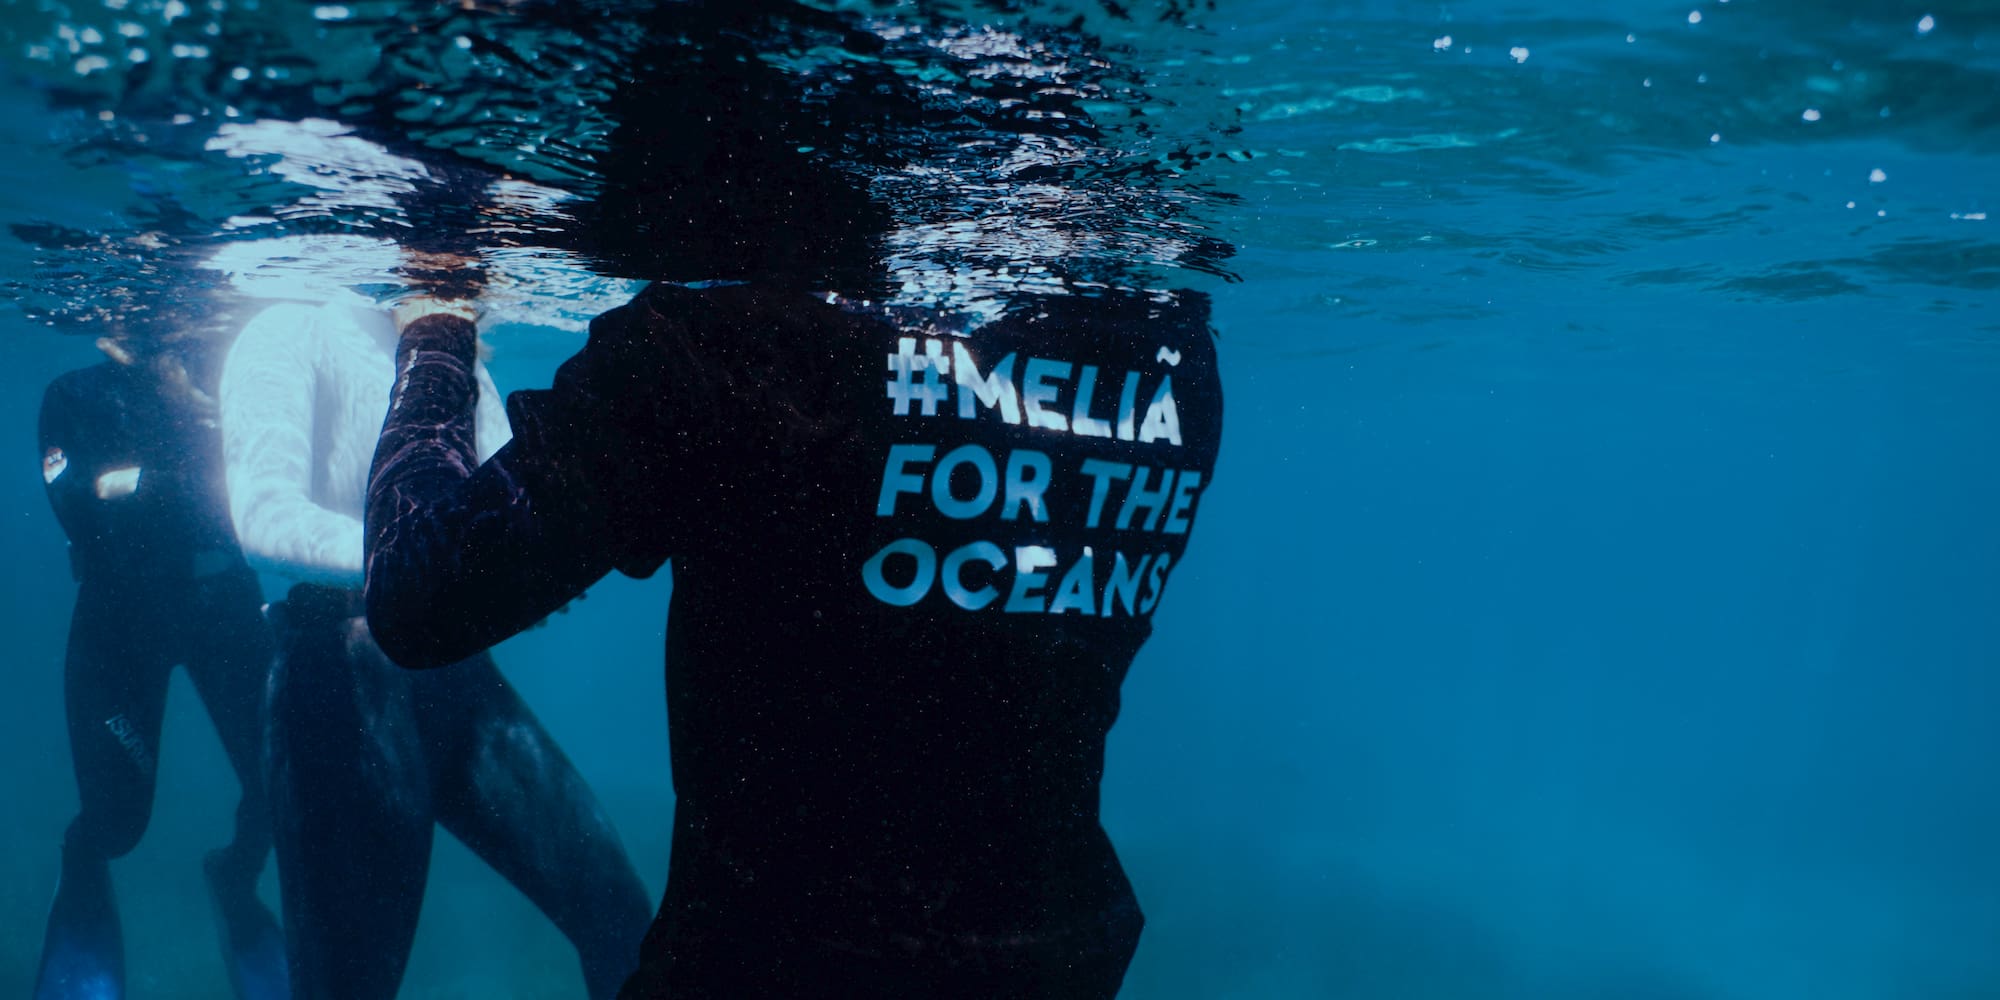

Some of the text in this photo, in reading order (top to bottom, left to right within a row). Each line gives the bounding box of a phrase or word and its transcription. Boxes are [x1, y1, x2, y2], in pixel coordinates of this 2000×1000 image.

[876, 444, 1200, 534] FOR THE
[862, 538, 1170, 618] OCEANS
